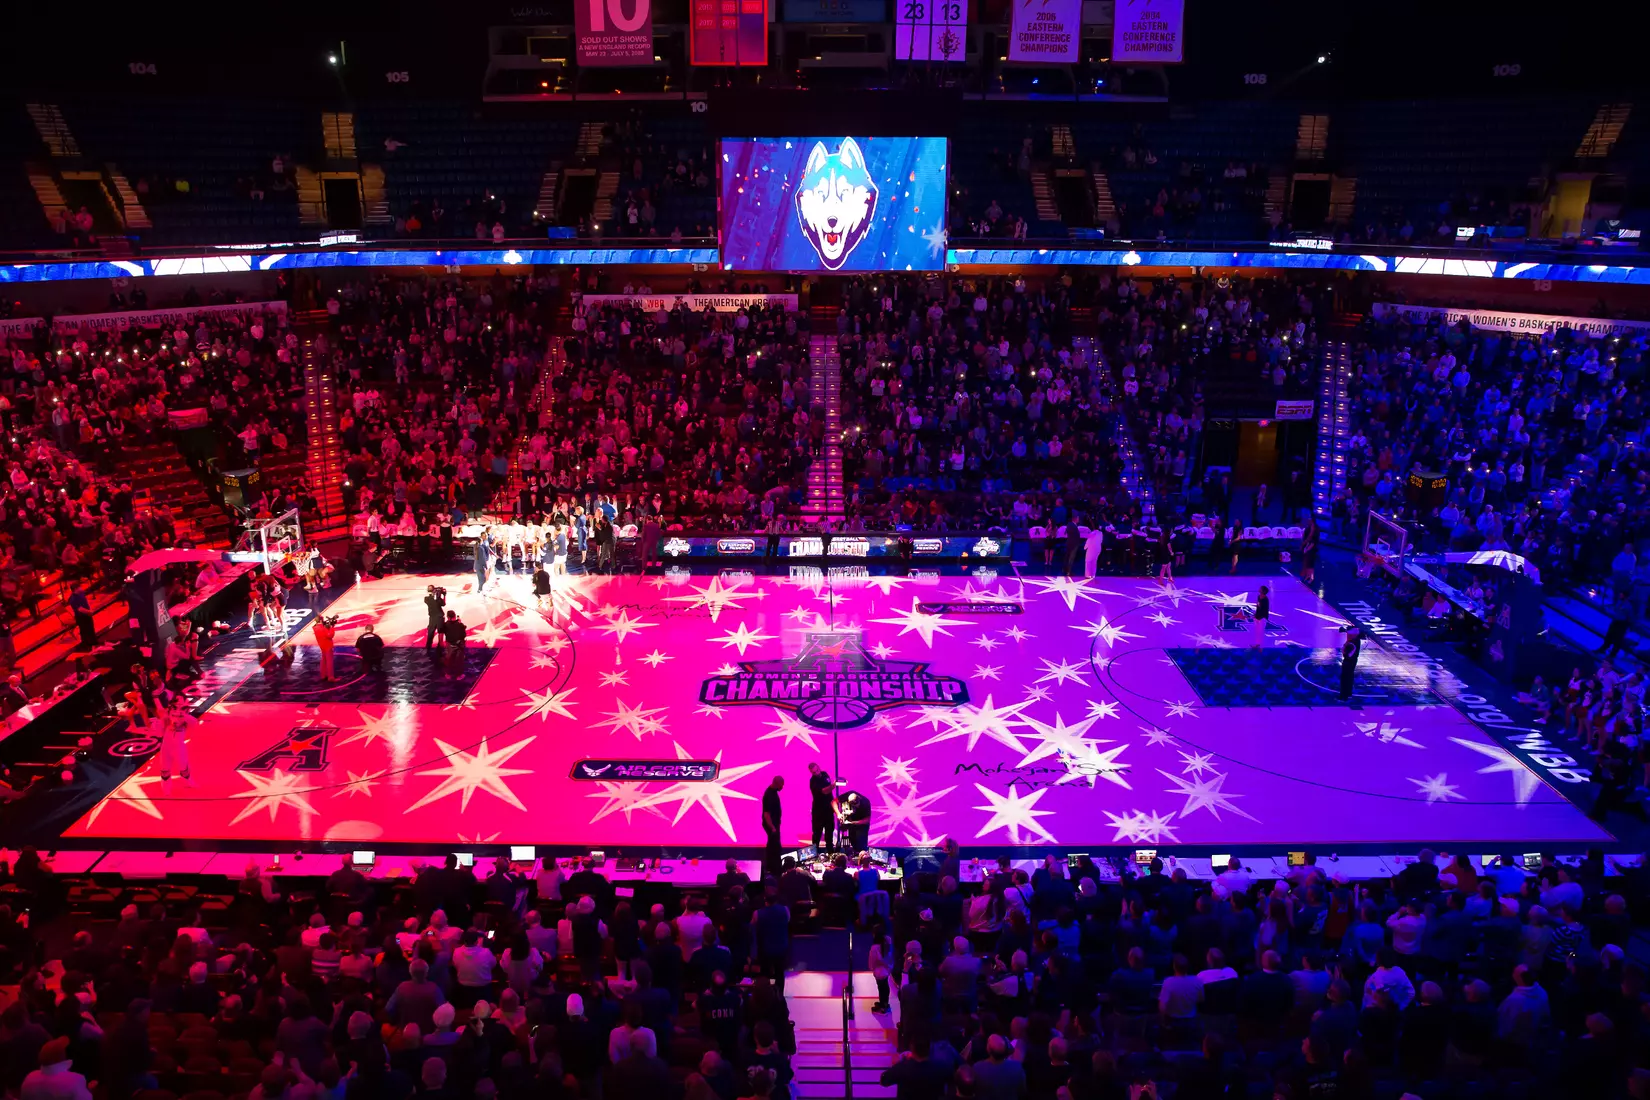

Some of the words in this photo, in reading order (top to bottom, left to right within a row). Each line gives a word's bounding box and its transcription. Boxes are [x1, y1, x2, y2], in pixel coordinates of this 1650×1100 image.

[904, 3, 925, 20] 23
[941, 4, 961, 20] 13
[1027, 22, 1064, 31] EASTERN
[1131, 21, 1168, 31] EASTERN
[581, 37, 601, 45] SOLD
[1018, 33, 1071, 43] CONFERENCE
[1122, 32, 1176, 42] CONFERENCE
[1020, 43, 1068, 53] CHAMPIONS
[1124, 42, 1174, 52] CHAMPIONS
[128, 62, 158, 75] 104
[1492, 63, 1521, 76] 109
[384, 71, 410, 83] 105
[1243, 73, 1268, 84] 108
[691, 101, 708, 112] 10
[1473, 315, 1517, 327] WOMEN'S
[2, 324, 21, 334] THE
[707, 681, 966, 701] CHAMPIONSHIP
[955, 762, 1072, 776] Mohegan
[1004, 776, 1093, 791] Arena
